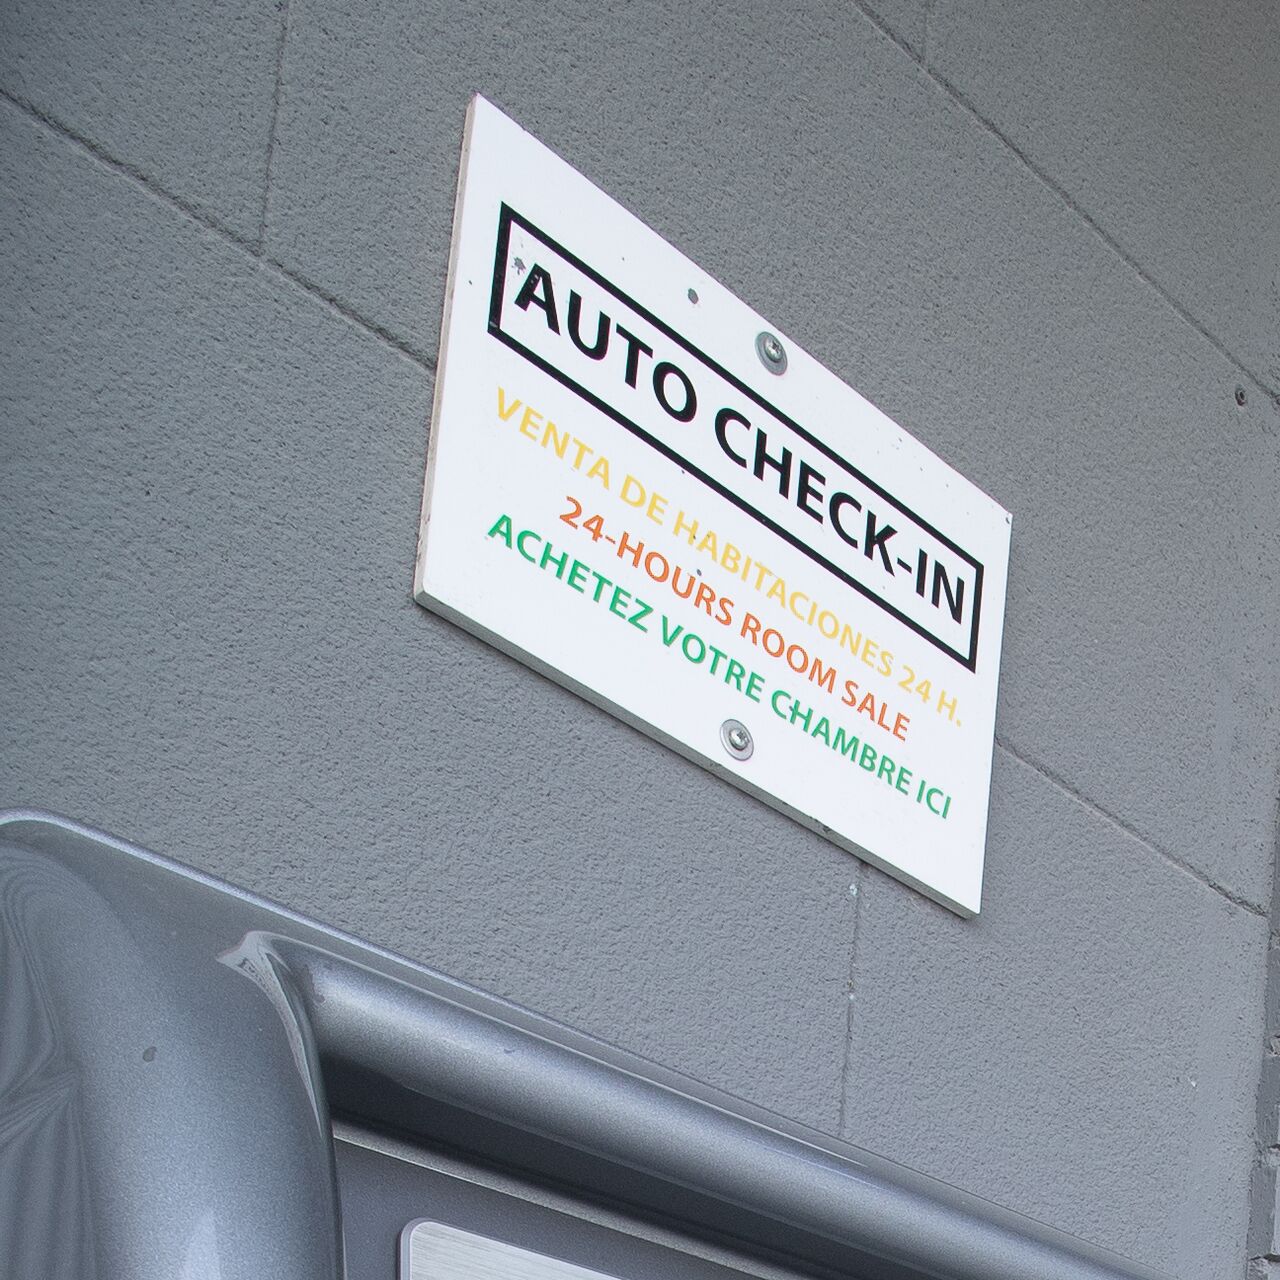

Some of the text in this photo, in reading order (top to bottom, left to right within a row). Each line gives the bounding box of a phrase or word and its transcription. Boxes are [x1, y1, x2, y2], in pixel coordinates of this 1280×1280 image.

[497, 387, 962, 727] VENTA DE HABITACIONES 24 H.
[514, 263, 968, 625] AUTO CHECK-IN
[487, 513, 952, 820] ACHETEZ VOTRE CHAMBRE ICI
[559, 496, 911, 742] 24-HOURS ROOM SALE
